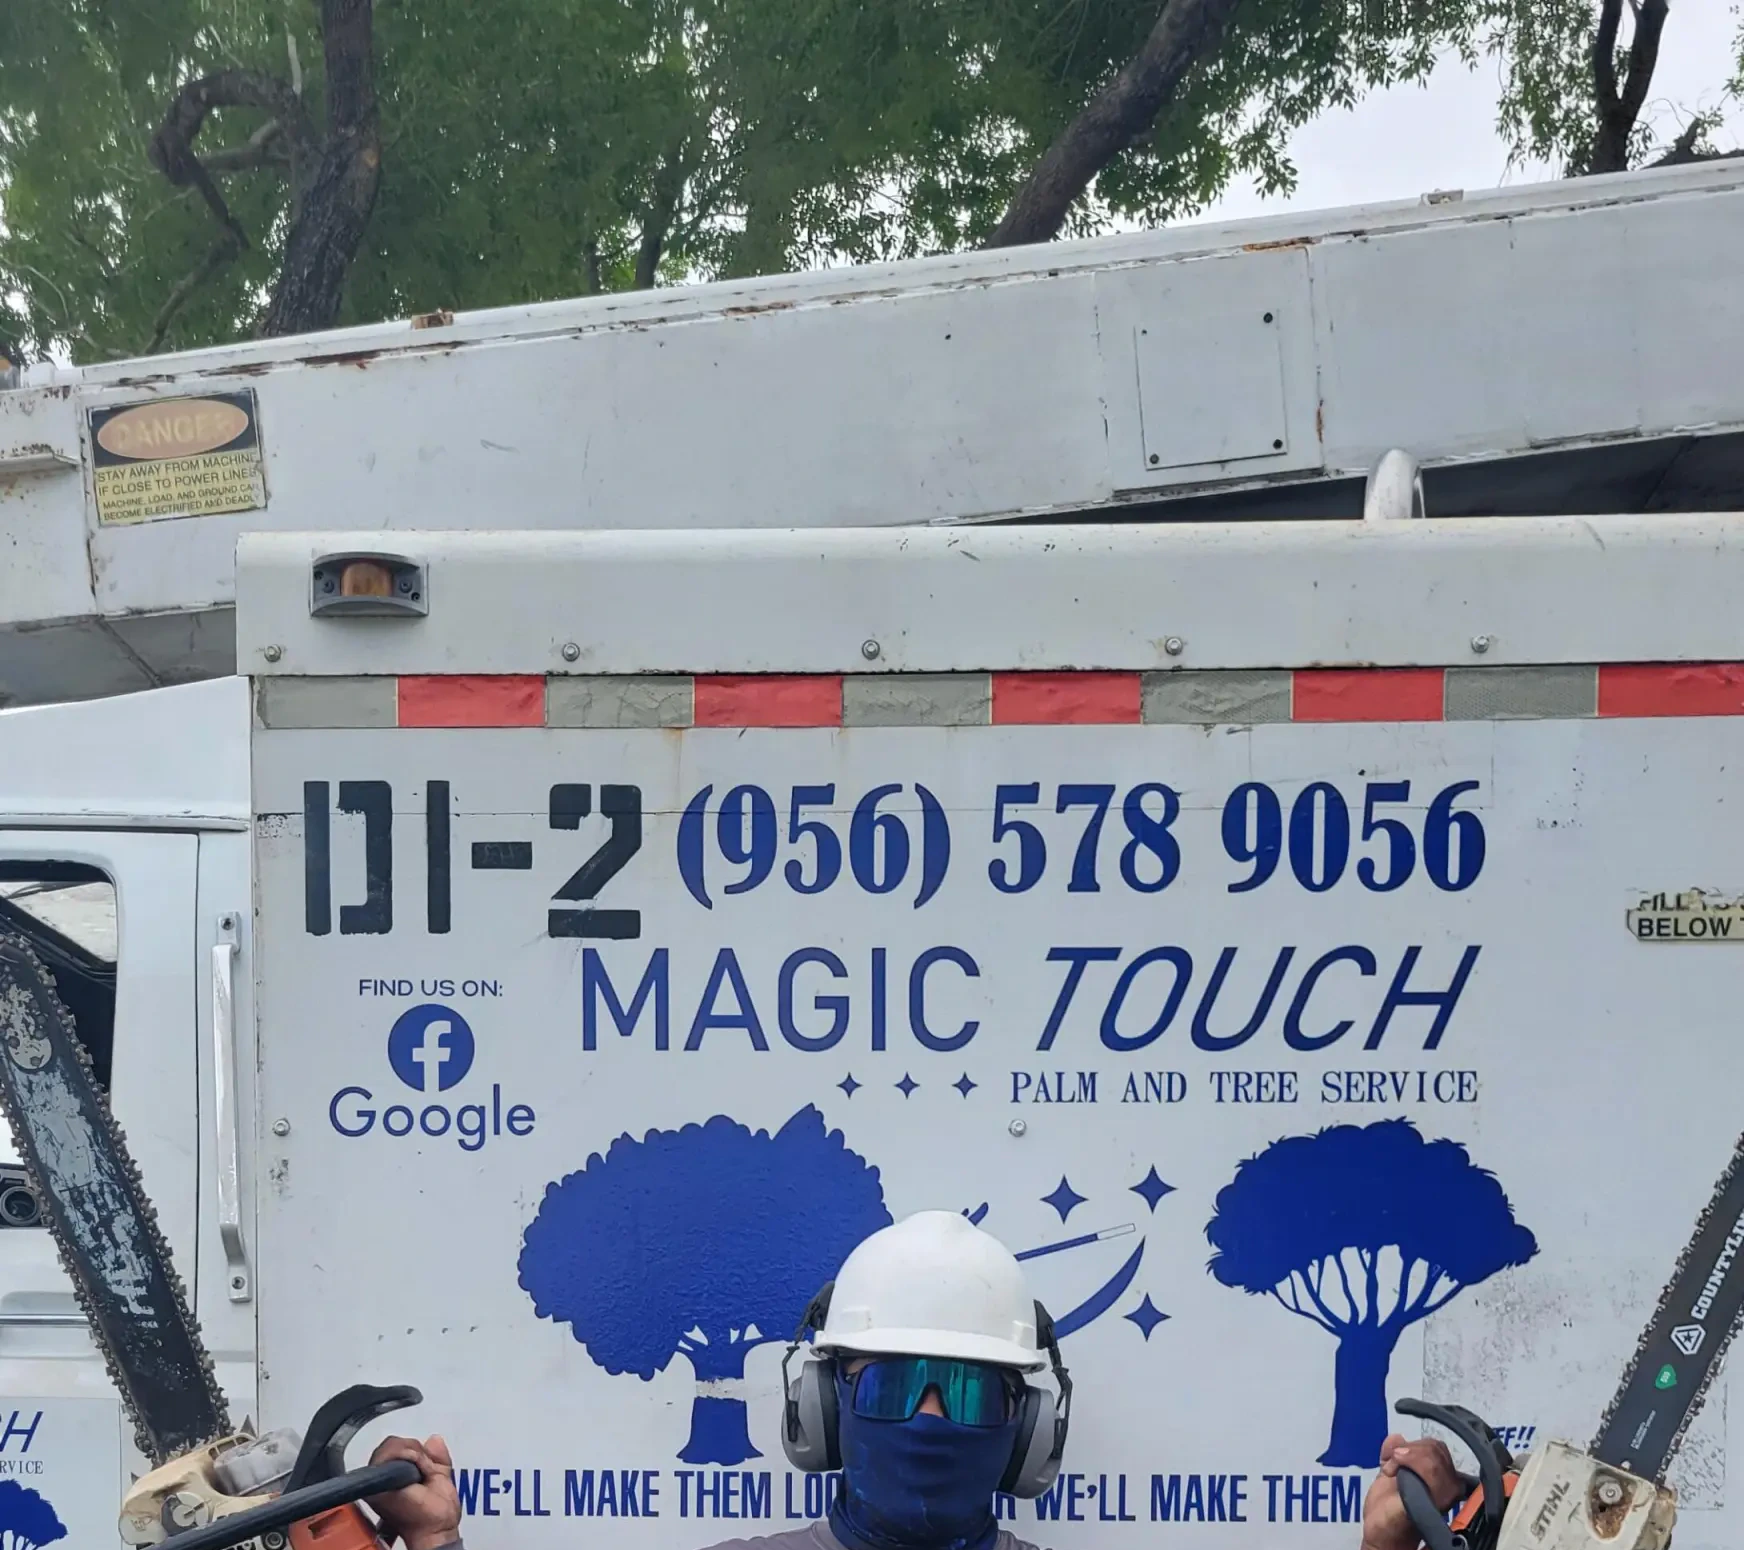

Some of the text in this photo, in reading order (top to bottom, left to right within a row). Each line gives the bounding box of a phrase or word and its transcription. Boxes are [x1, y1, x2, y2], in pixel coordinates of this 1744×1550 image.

[111, 410, 236, 450] DANGER
[98, 468, 127, 483] STAY
[129, 464, 161, 478] AWAY
[165, 460, 200, 473] FROM
[98, 486, 110, 497] IF
[112, 479, 153, 495] CLOSE
[155, 478, 171, 491] TO
[174, 472, 220, 487] POWER
[177, 489, 197, 500] AND
[199, 486, 238, 498] GROUND
[104, 506, 142, 521] BECOME
[145, 500, 202, 516] ELECTRIFIED
[204, 497, 223, 509] AND
[676, 779, 1486, 911] (956) 578 9056
[1637, 917, 1733, 938] BELOW
[359, 979, 504, 998] FIND US ON:
[582, 944, 1483, 1053] MAGIC TOUCH
[1010, 1070, 1479, 1103] PALM AND TREE SERVICE
[328, 1084, 536, 1152] Google
[0, 1410, 44, 1453] H
[1493, 1426, 1537, 1449] FF!!
[0, 1460, 44, 1474] RVICE
[451, 1468, 551, 1517] WE'LL
[564, 1469, 660, 1518] MAKE
[673, 1470, 772, 1519] THEM
[785, 1471, 843, 1520] LOO
[1150, 1474, 1248, 1523] MAKE
[1262, 1474, 1361, 1523] THEM
[1530, 1481, 1571, 1542] STIHL
